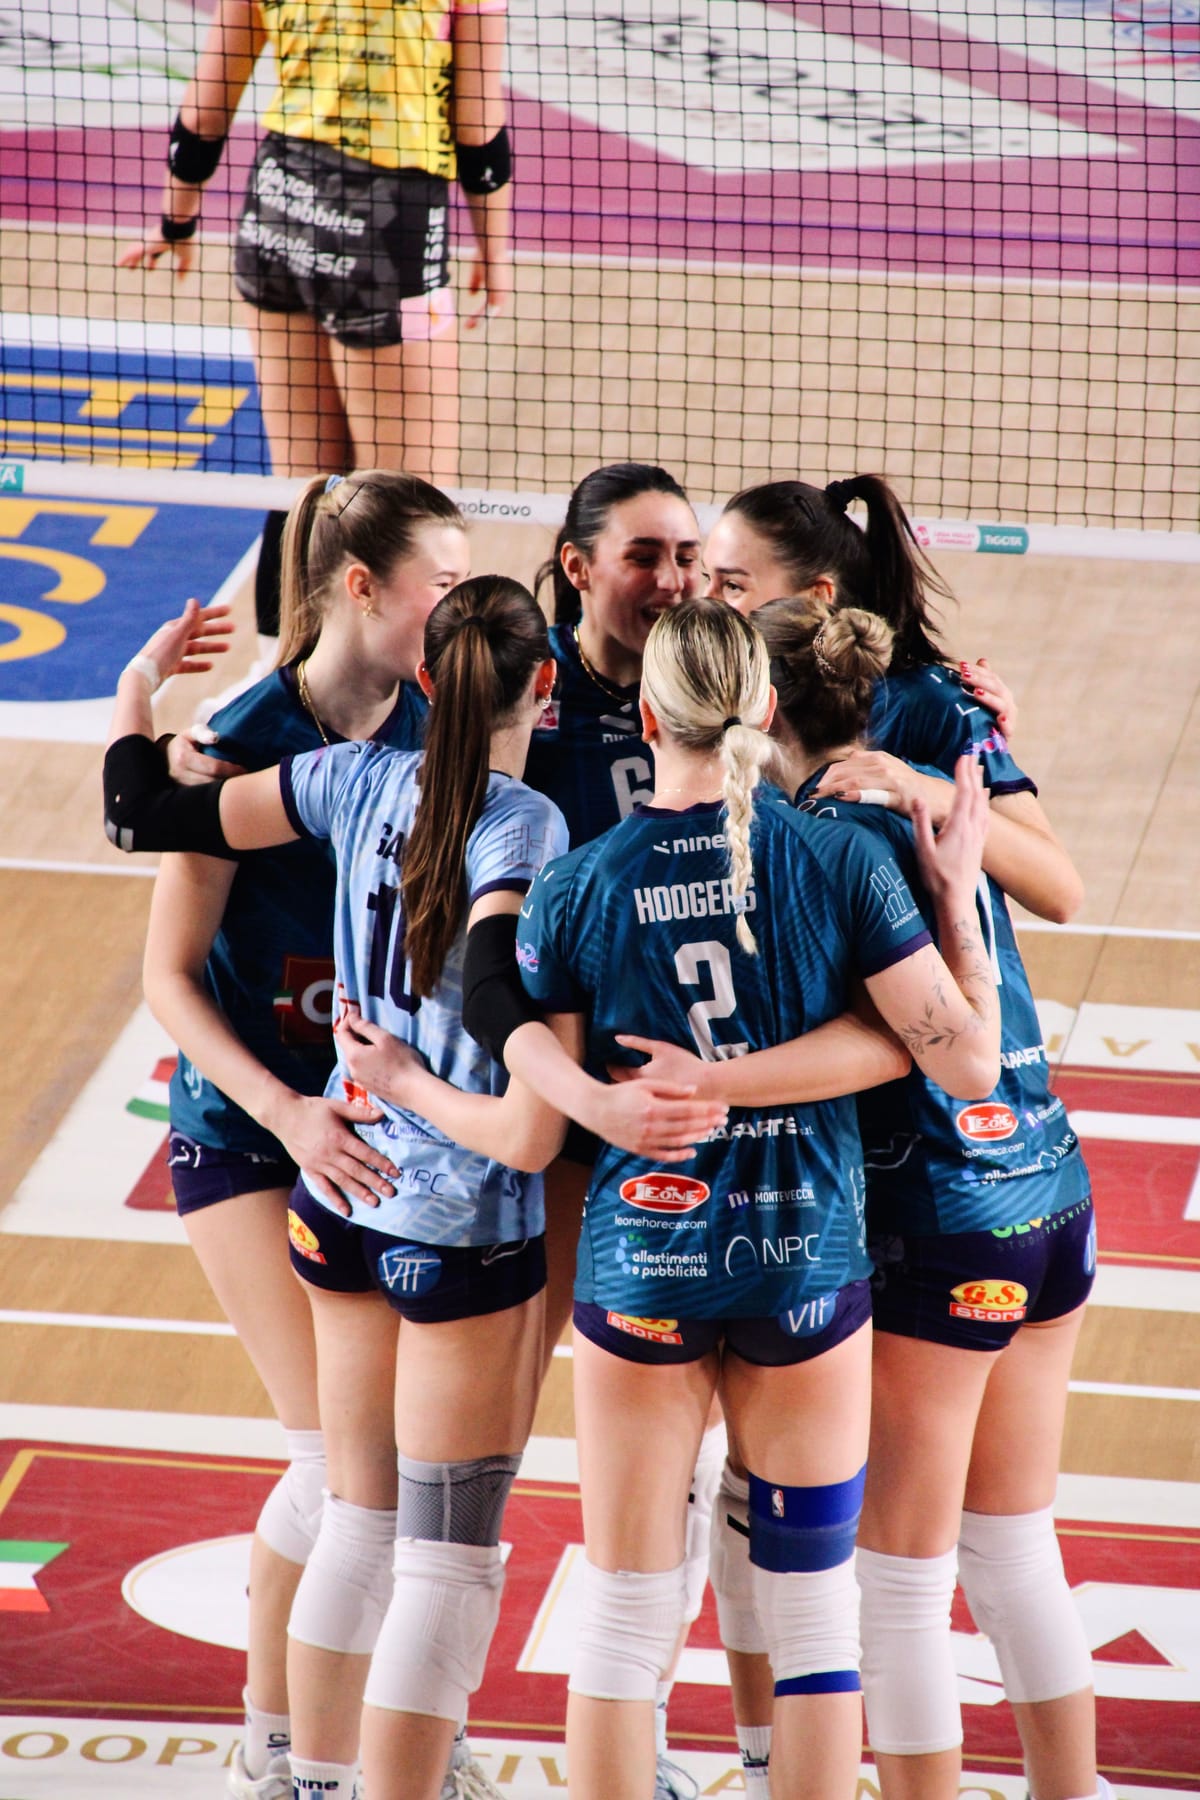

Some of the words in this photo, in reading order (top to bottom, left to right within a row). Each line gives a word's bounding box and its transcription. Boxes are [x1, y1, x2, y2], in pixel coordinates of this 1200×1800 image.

[672, 834, 727, 855] nine
[673, 940, 749, 1062] 2
[614, 1213, 707, 1231] leonehoreca.com
[632, 1249, 708, 1265] allestimenti
[762, 1233, 822, 1265] NPC
[641, 1263, 708, 1279] pubblicità
[962, 1284, 1022, 1306] G.S.
[955, 1305, 1024, 1322] store
[609, 1313, 678, 1344] store
